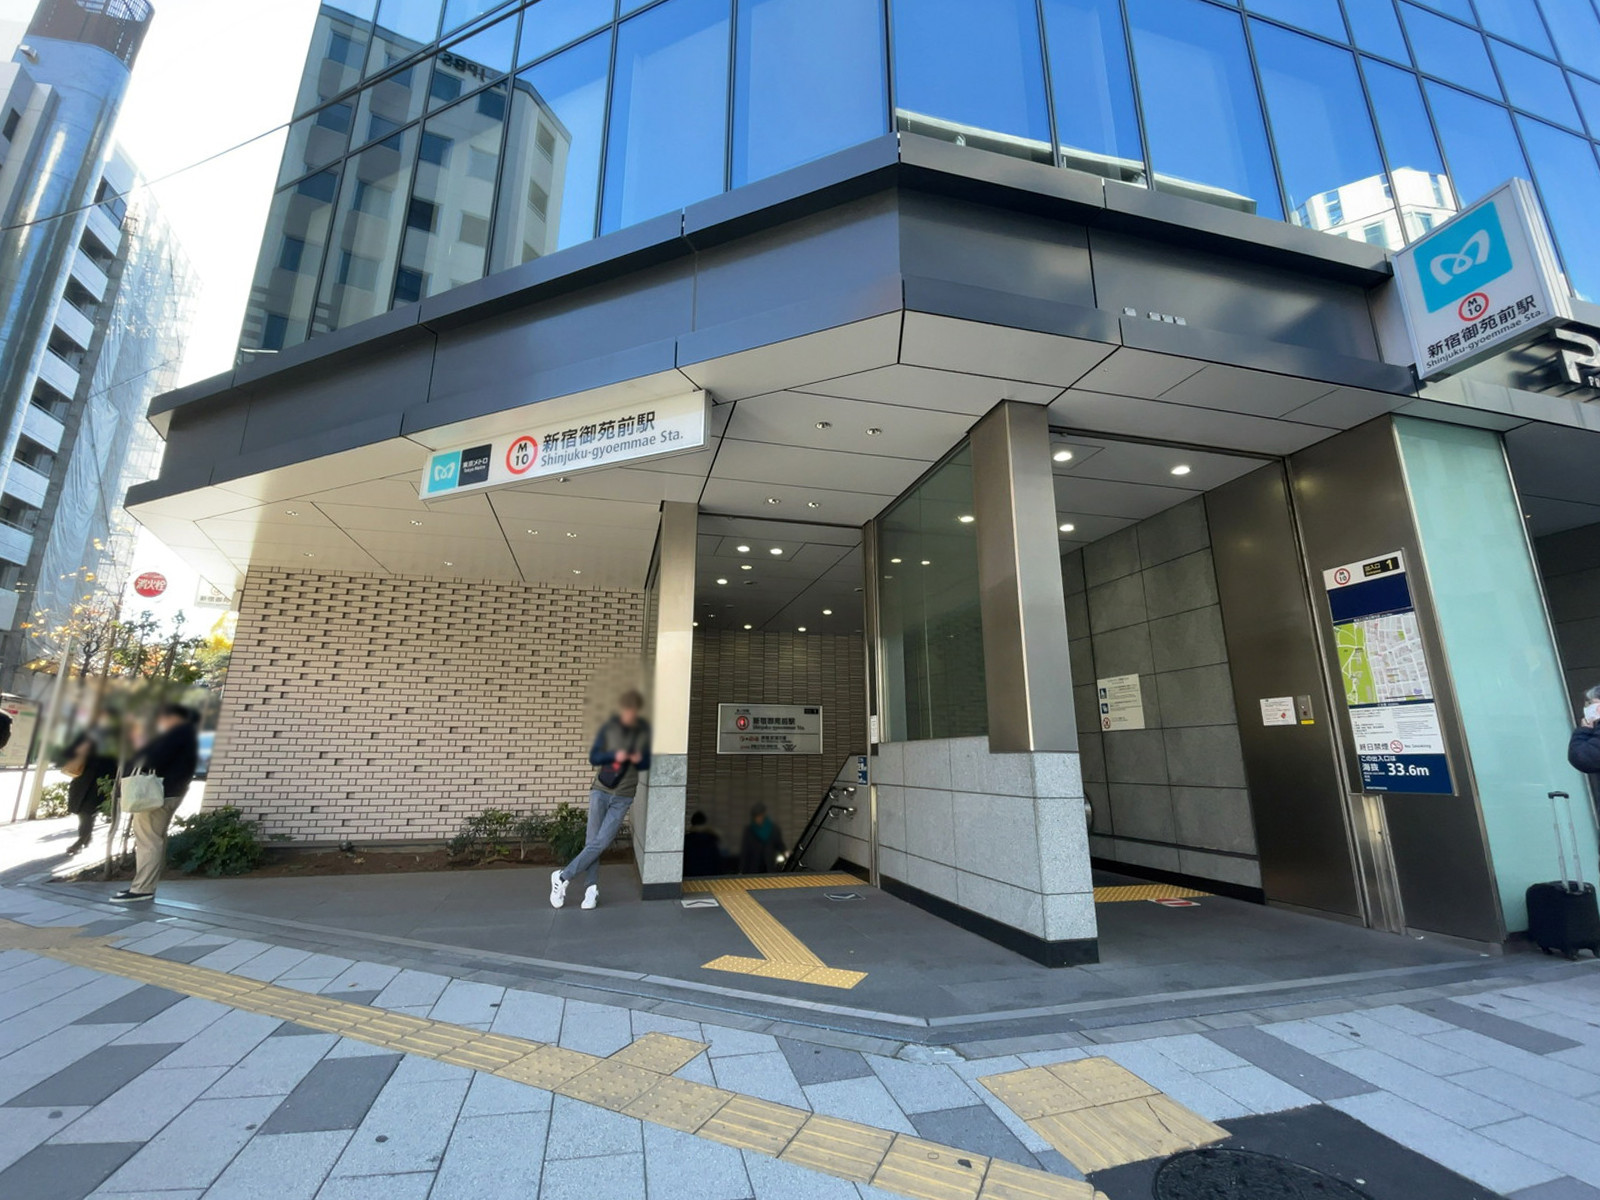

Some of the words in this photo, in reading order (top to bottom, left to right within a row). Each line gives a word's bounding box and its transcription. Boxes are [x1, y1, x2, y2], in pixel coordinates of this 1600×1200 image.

[1467, 297, 1478, 307] M
[1468, 304, 1482, 316] 10
[1427, 294, 1537, 359] 新宿御苑前駅
[1426, 320, 1522, 369] Shinjuku-gyoemmae
[1524, 309, 1545, 323] Sta.
[542, 410, 656, 452] 新宿御苑前駅
[517, 443, 528, 452] M
[540, 434, 656, 468] Shinjuku-gyoemmae
[659, 429, 684, 443] Sta.
[514, 454, 529, 466] 10
[1386, 559, 1393, 570] 1
[136, 578, 166, 591] 消火栓
[1386, 762, 1429, 776] 33.6m
